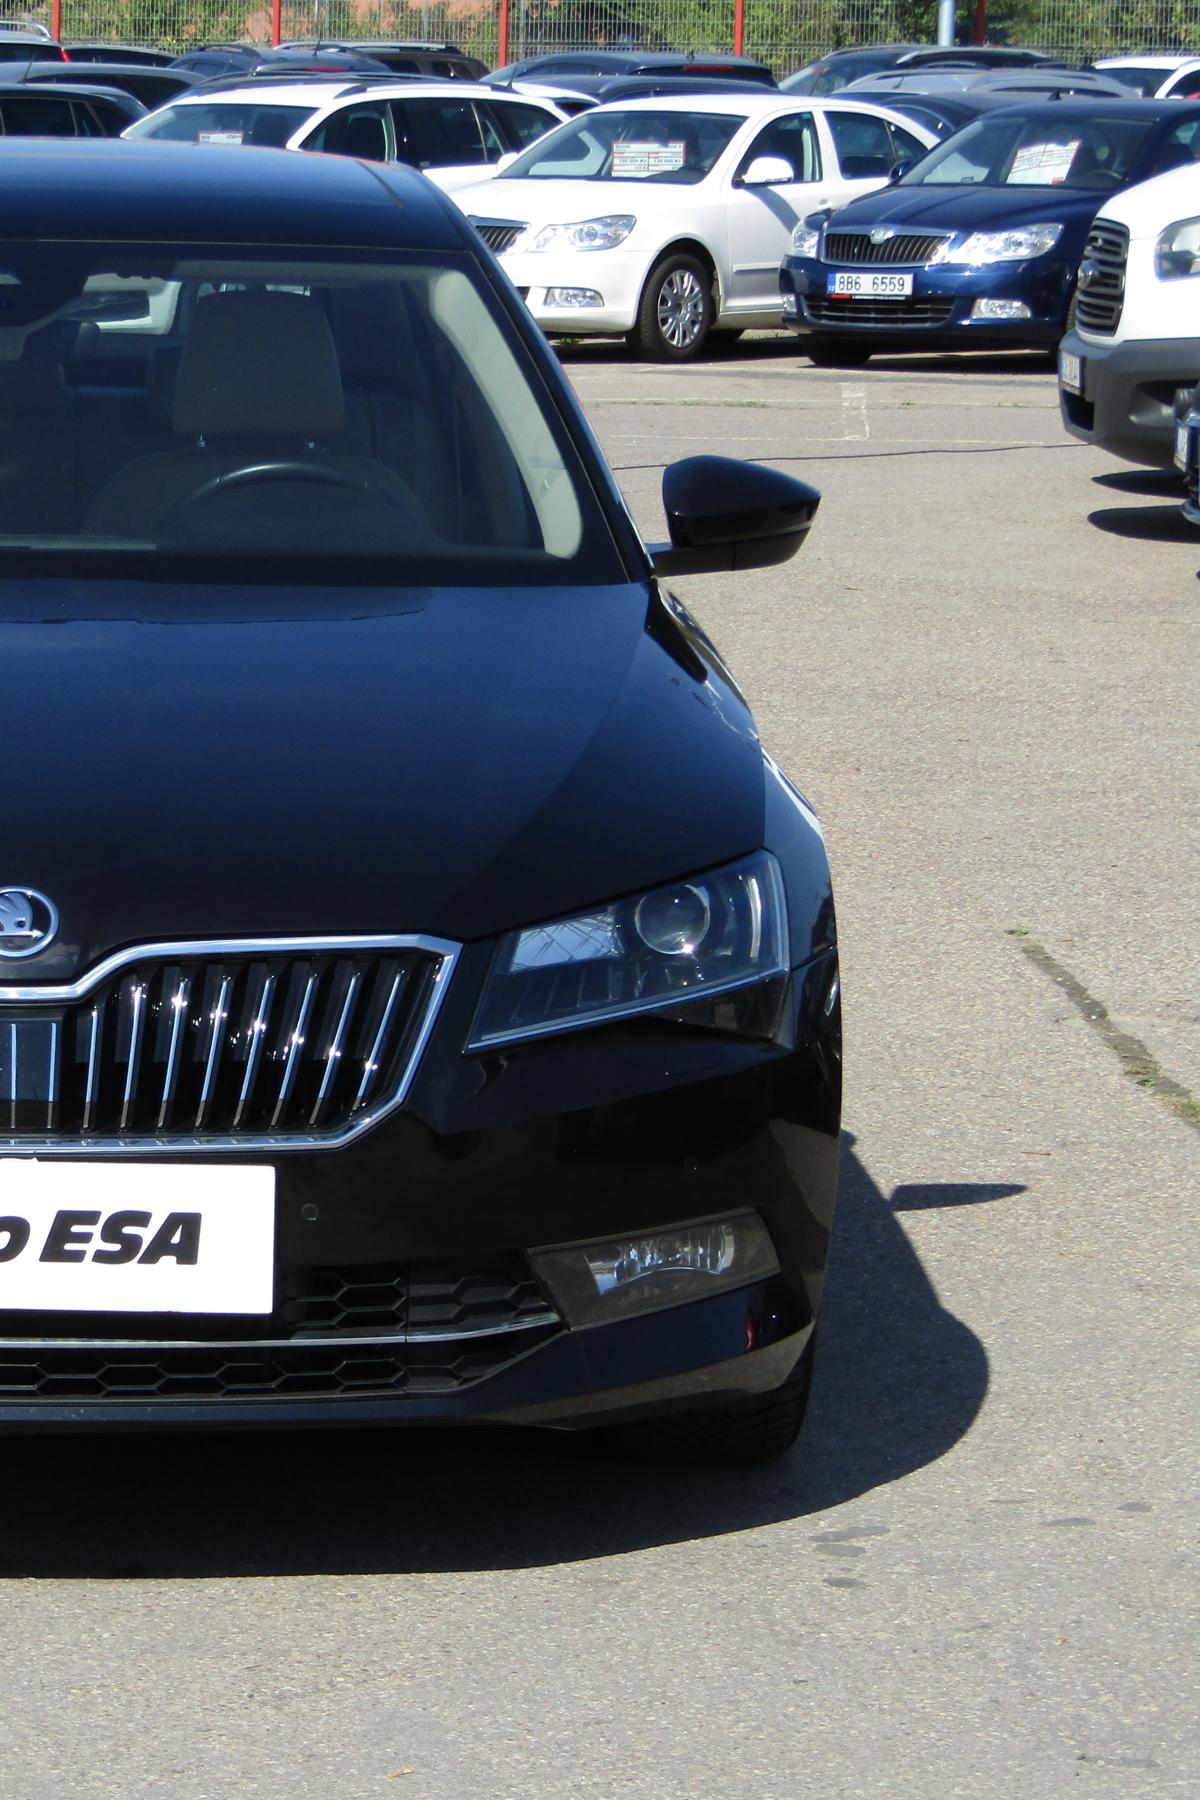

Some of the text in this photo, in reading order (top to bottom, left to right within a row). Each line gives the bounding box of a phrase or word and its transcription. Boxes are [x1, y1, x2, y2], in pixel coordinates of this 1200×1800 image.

[838, 275, 905, 293] 8B6 6559
[38, 1209, 203, 1265] ESA
